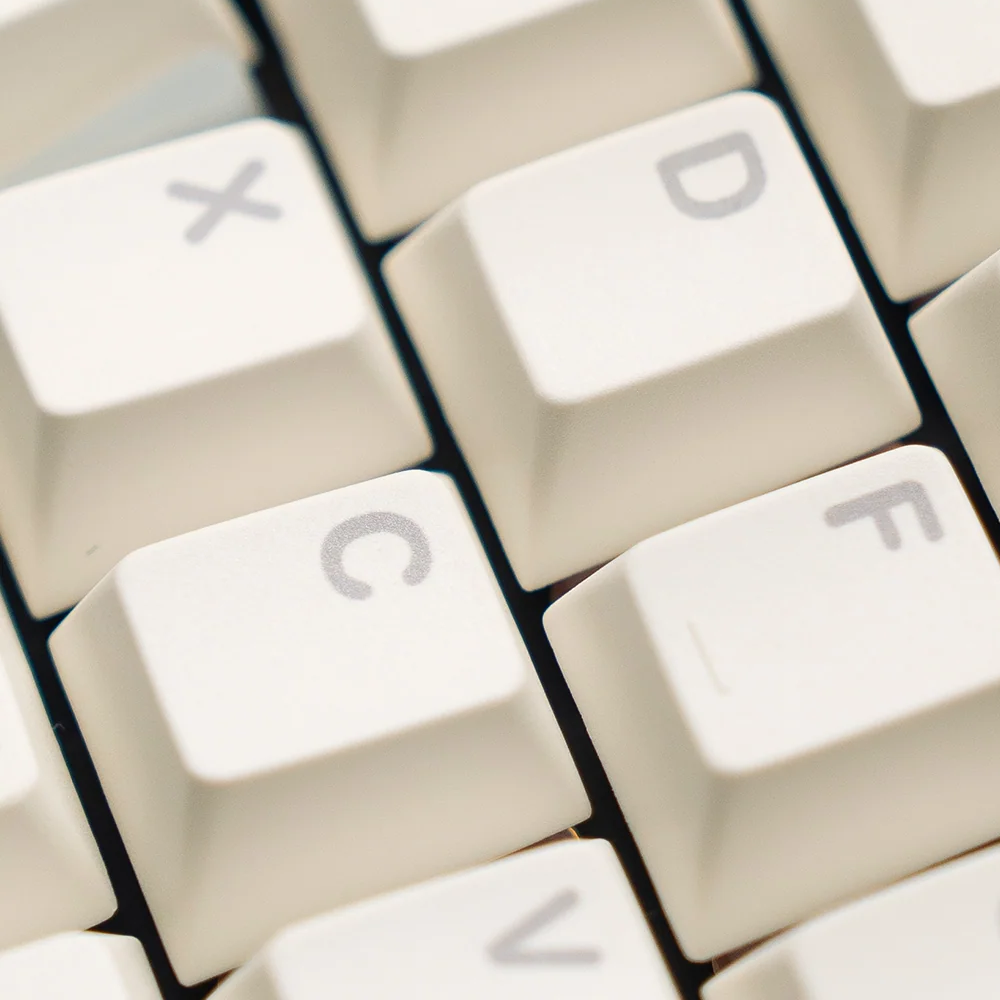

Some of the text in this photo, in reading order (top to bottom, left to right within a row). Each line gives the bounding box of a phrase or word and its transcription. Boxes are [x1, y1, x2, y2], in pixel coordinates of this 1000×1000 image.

[165, 159, 282, 246] X
[657, 131, 766, 219] D
[320, 511, 432, 601] C
[824, 479, 943, 550] F
[484, 888, 601, 968] V
